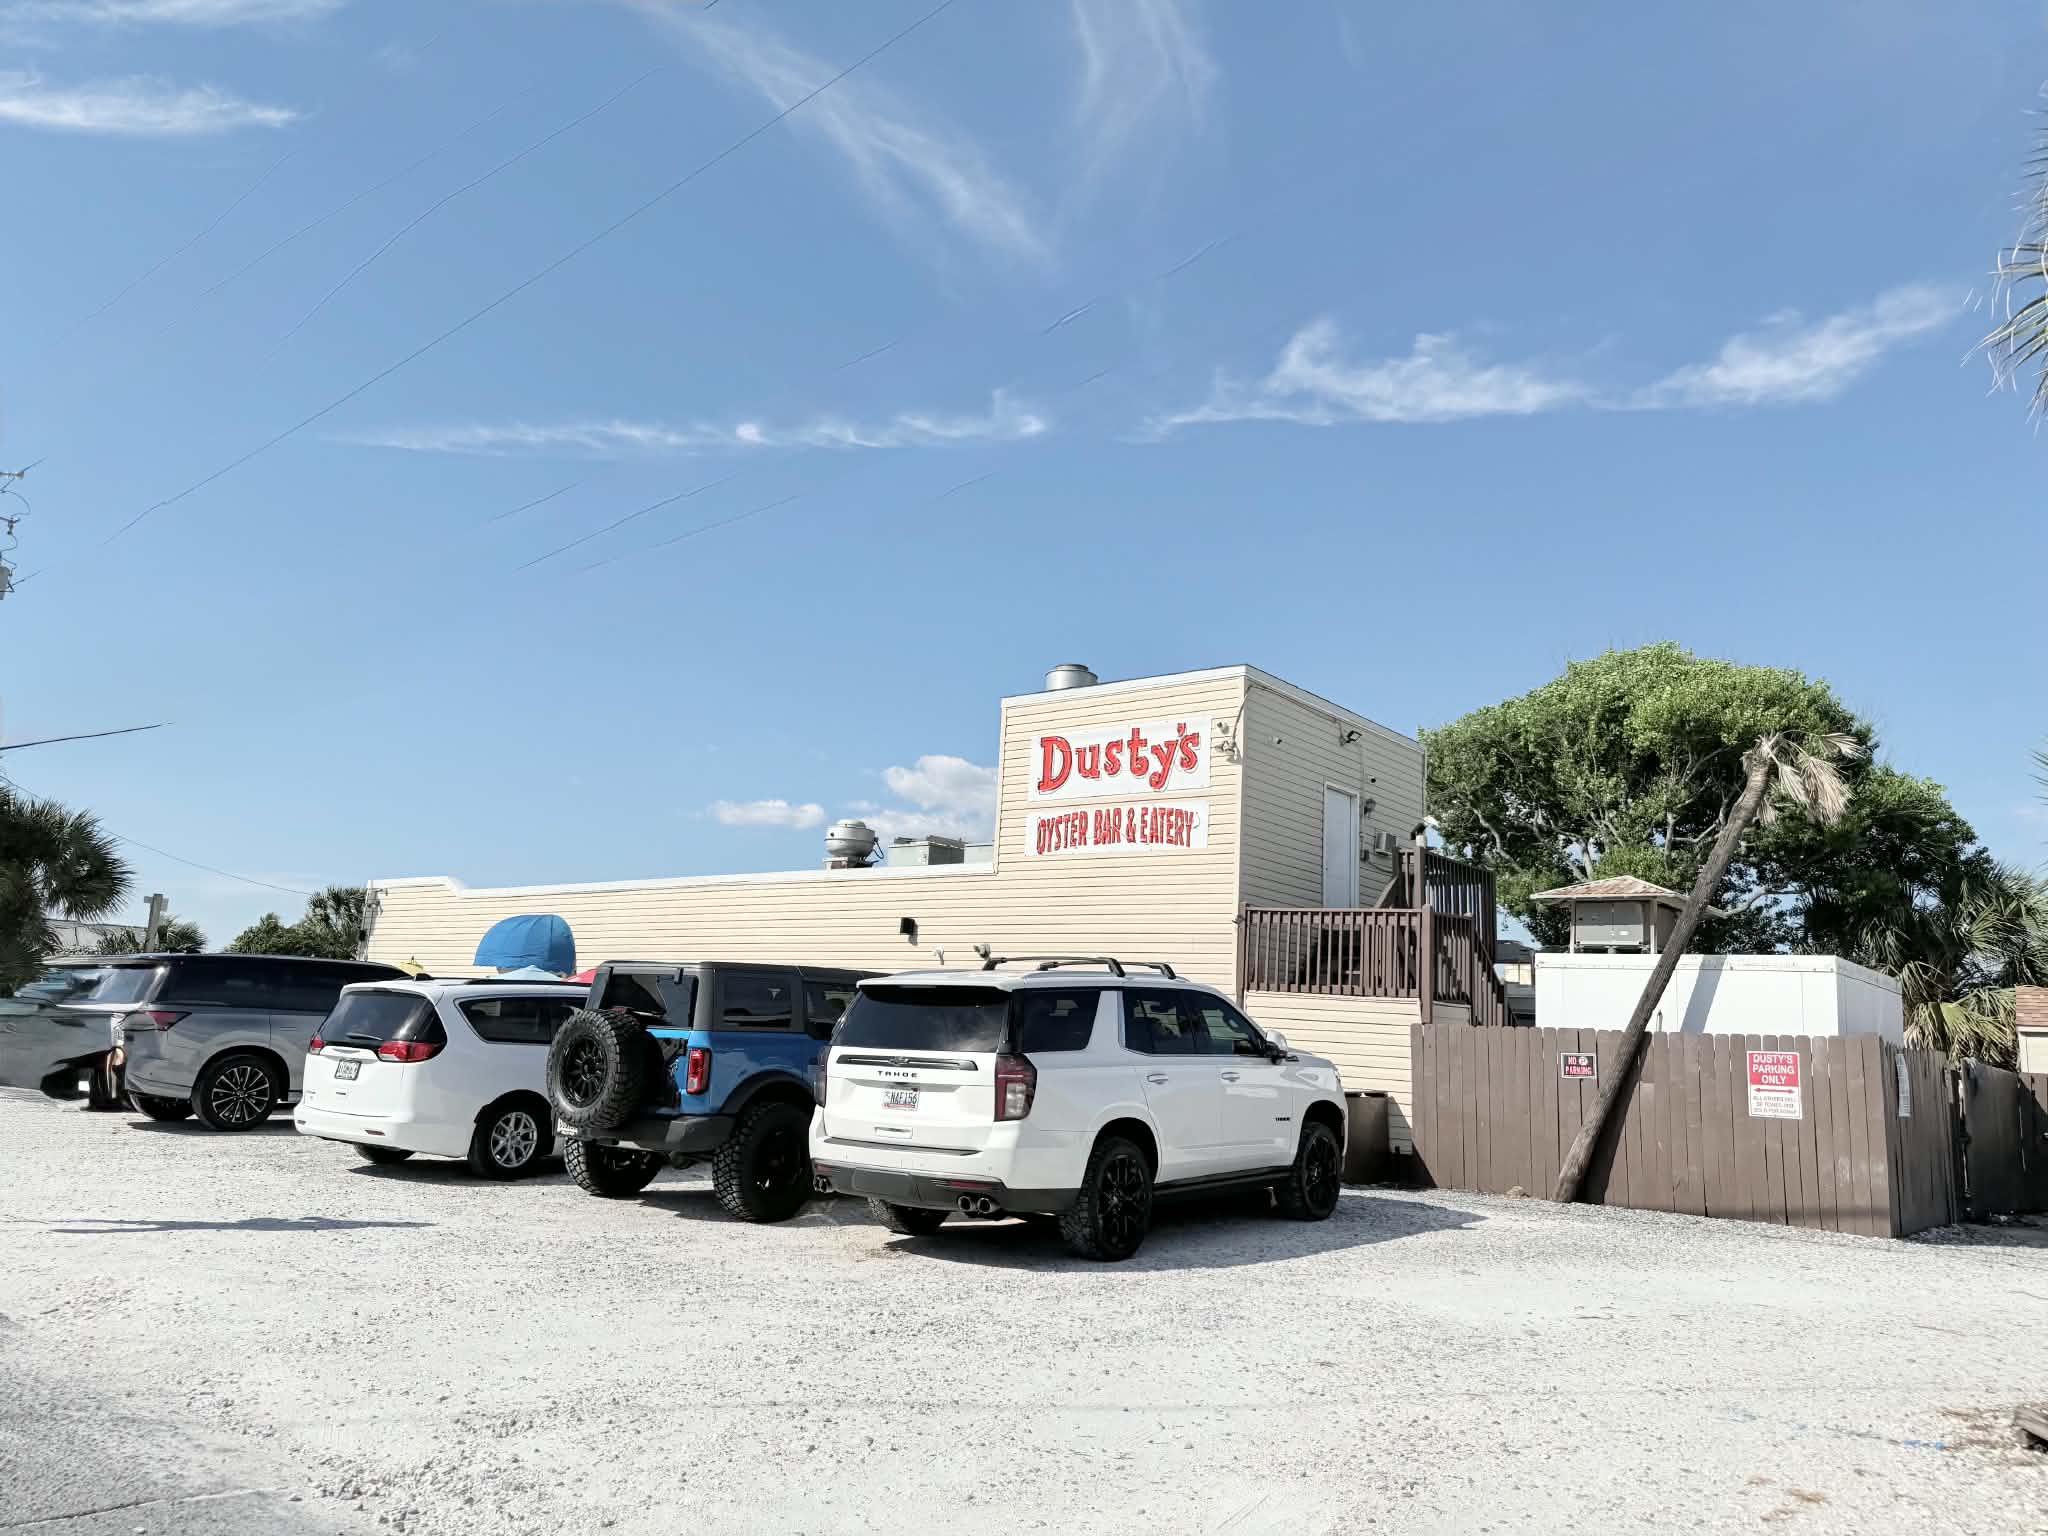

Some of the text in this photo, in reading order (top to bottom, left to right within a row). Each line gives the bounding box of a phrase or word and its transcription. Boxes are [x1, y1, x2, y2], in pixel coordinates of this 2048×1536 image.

[1037, 723, 1200, 792] Dusty's
[1036, 807, 1194, 855] OYSTER BAR & EATERY
[1568, 1056, 1577, 1065] NO
[1752, 1054, 1793, 1064] DUSTY'S
[877, 1070, 917, 1078] TAHOE
[1752, 1064, 1794, 1074] PARKING
[1761, 1075, 1786, 1084] ONLY
